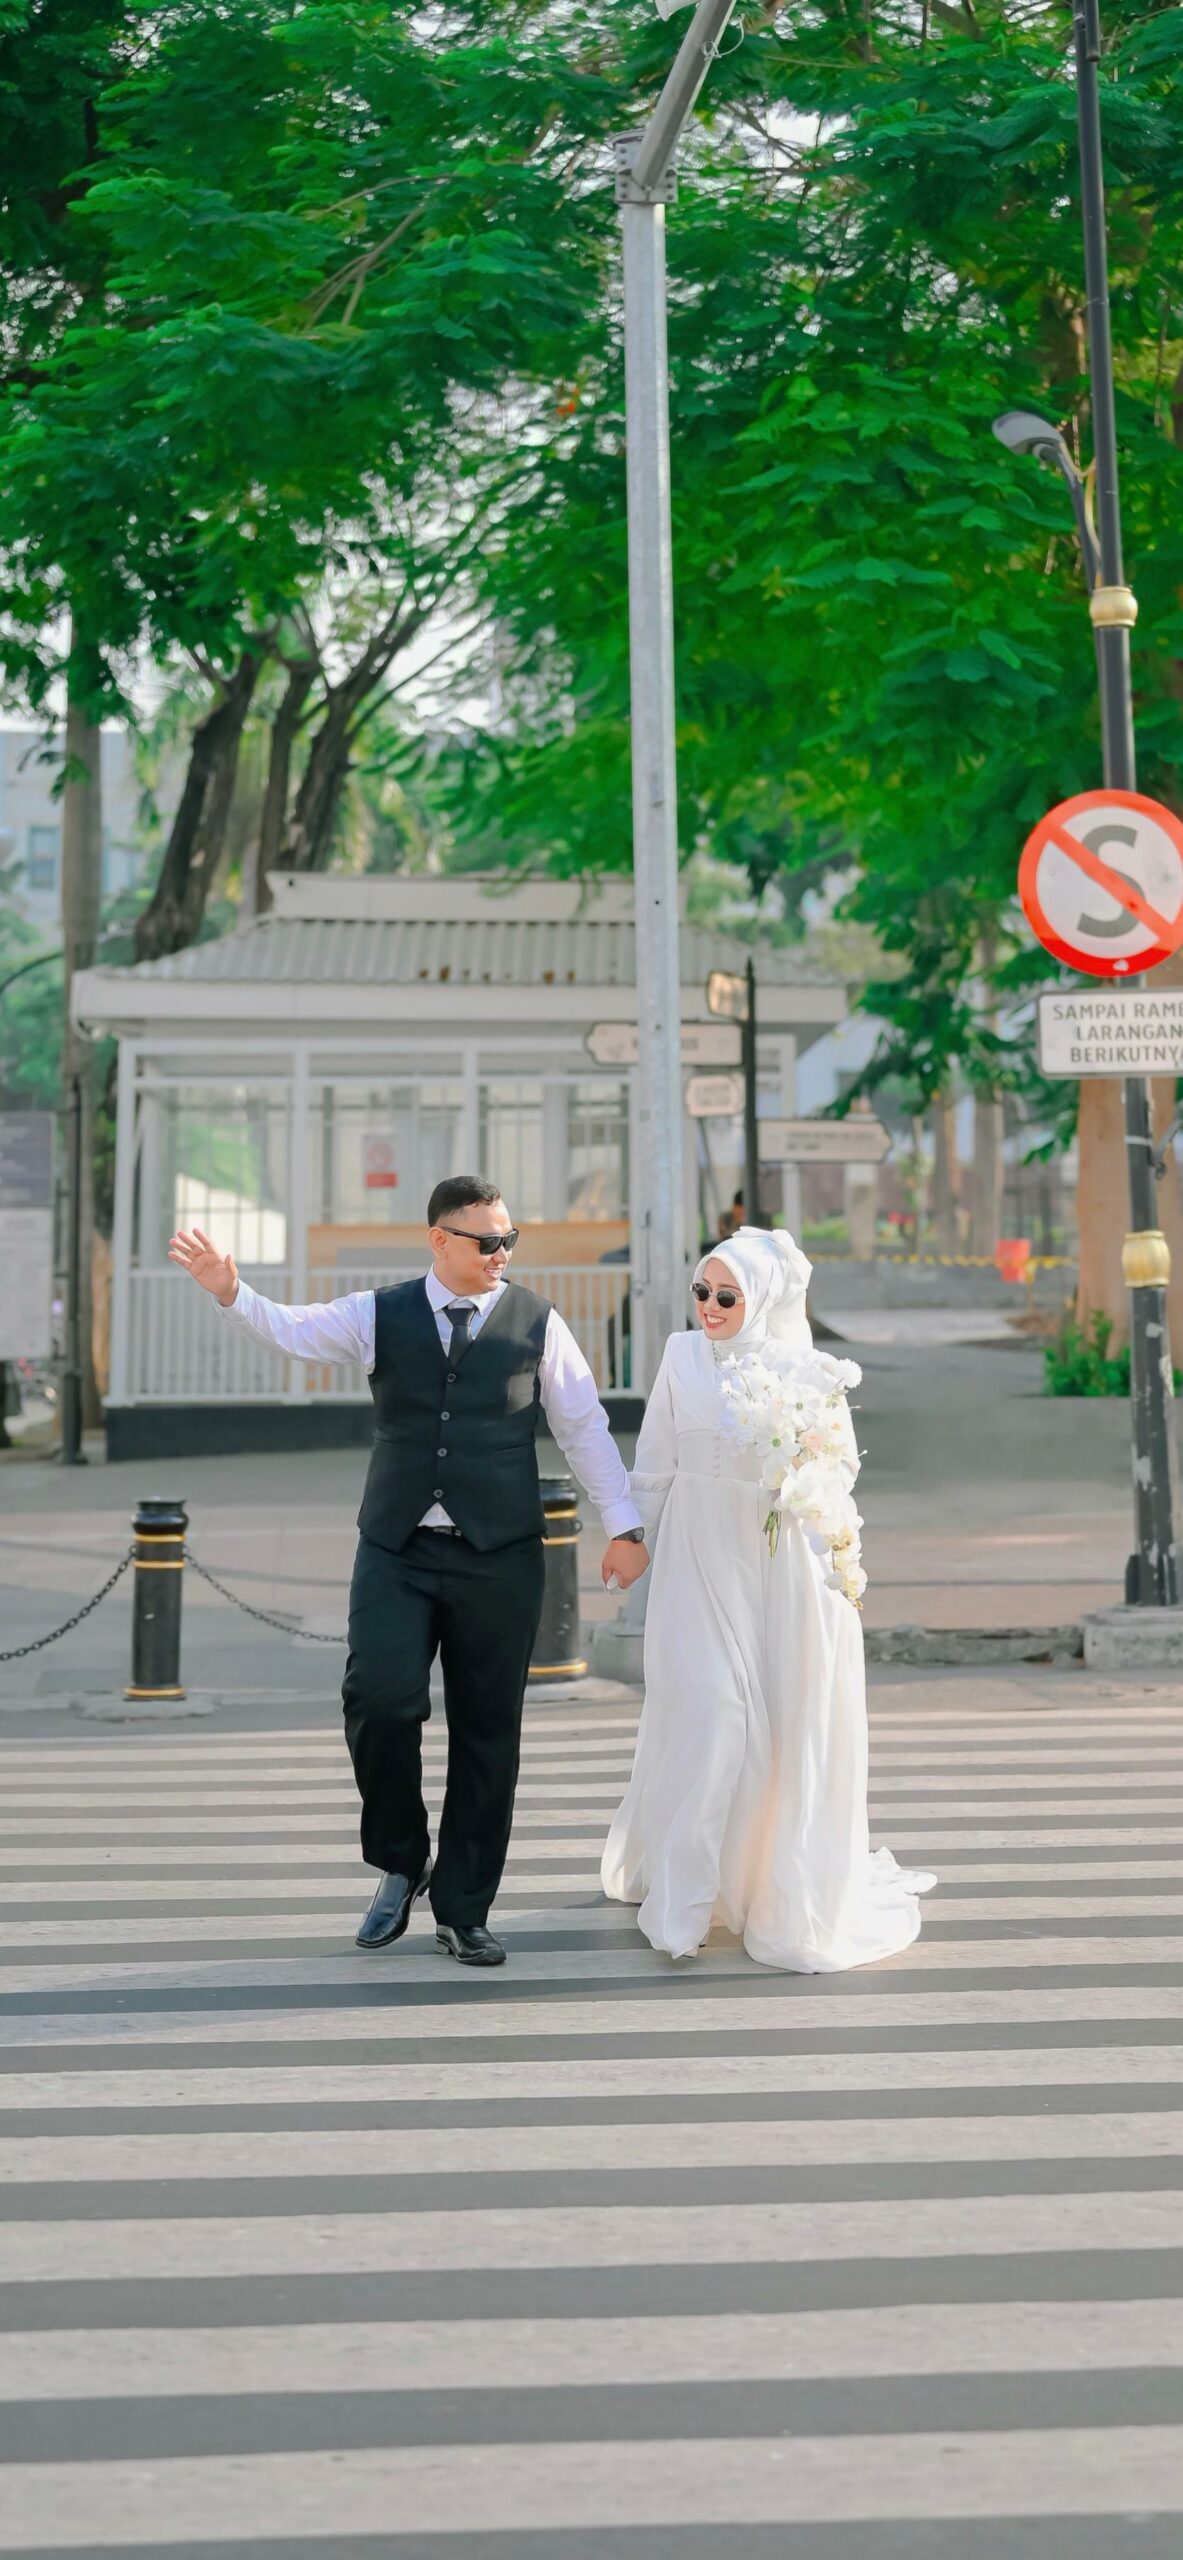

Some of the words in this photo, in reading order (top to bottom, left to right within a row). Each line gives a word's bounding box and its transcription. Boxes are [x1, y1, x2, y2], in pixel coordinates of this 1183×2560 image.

[1077, 824, 1146, 938] S
[1053, 1003, 1125, 1020] SAMPAI
[1076, 1024, 1183, 1040] LARANGAN
[1071, 1046, 1183, 1062] BERIKUTNY
